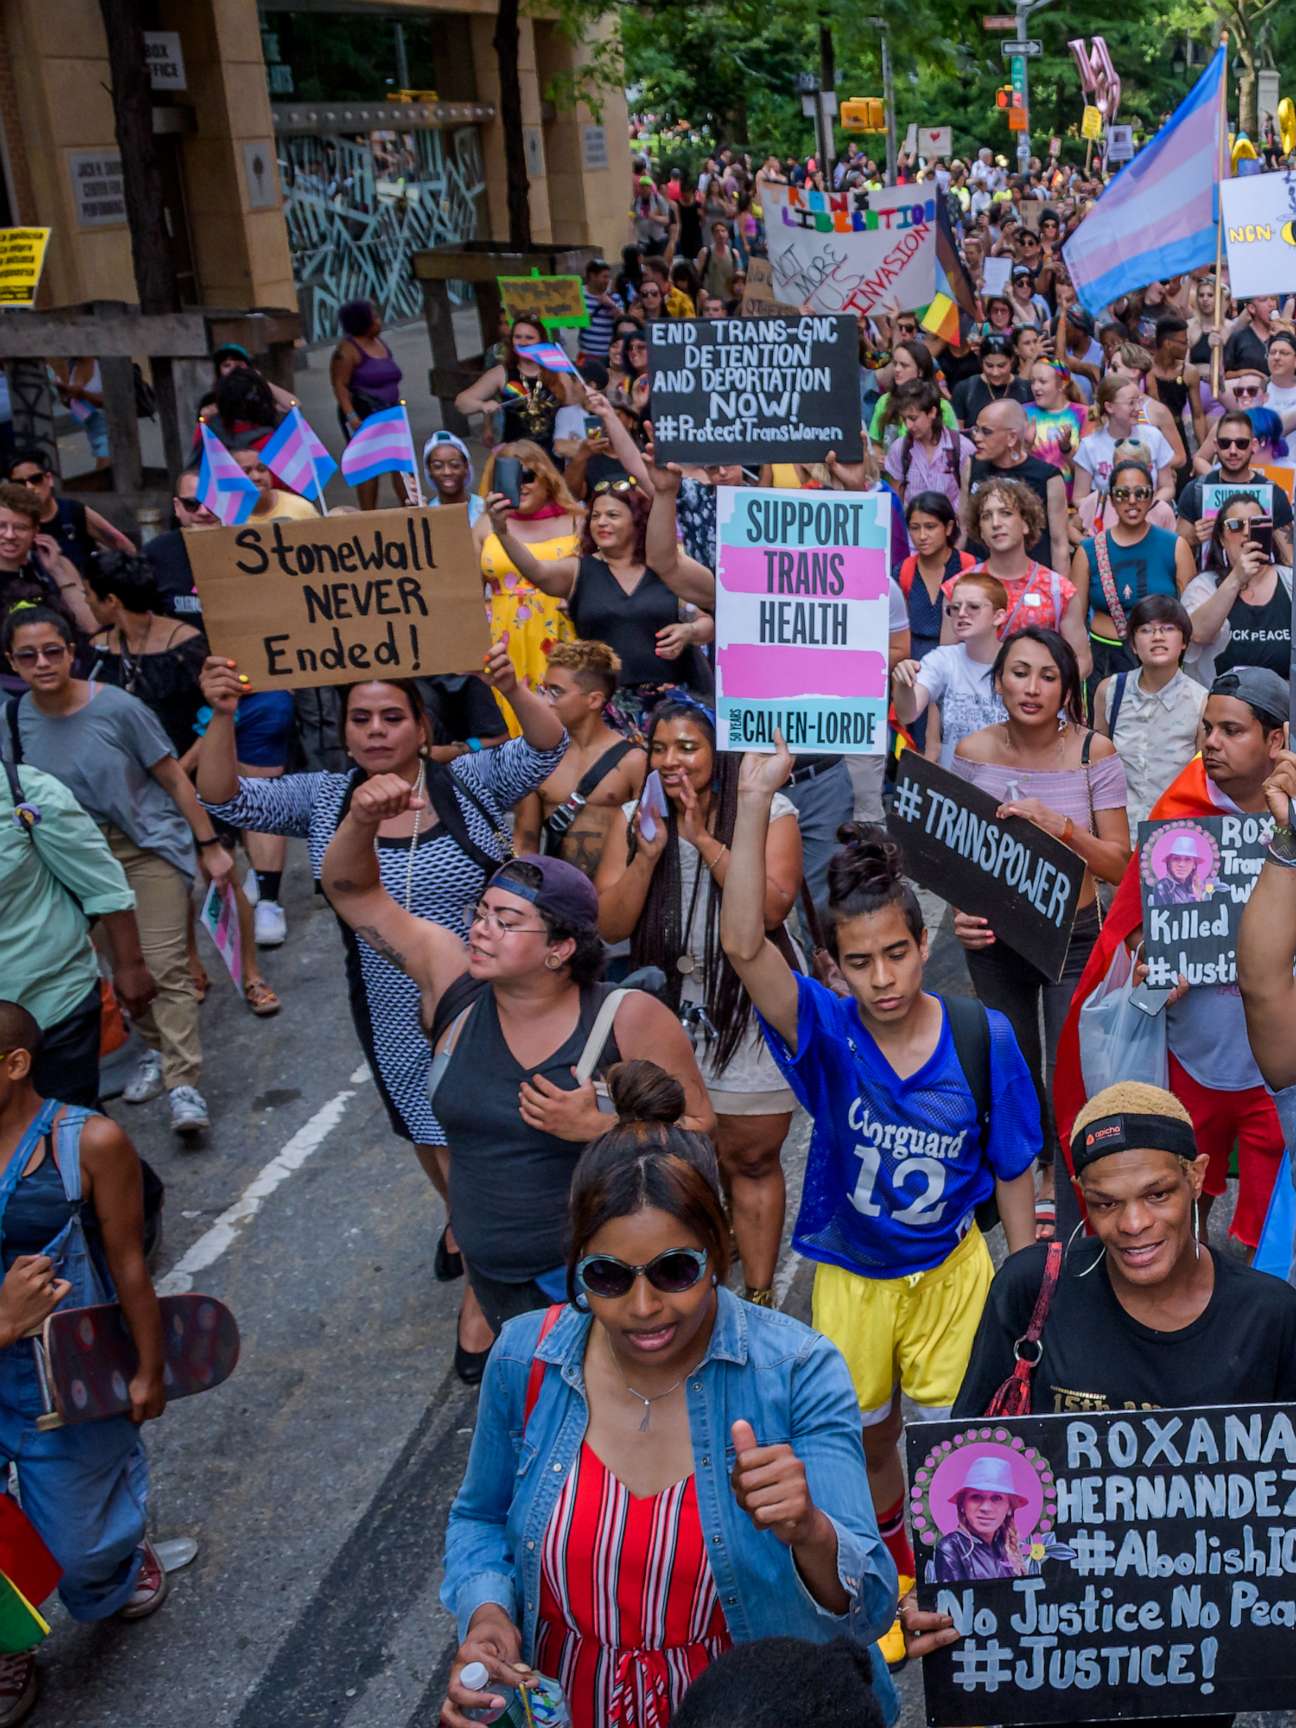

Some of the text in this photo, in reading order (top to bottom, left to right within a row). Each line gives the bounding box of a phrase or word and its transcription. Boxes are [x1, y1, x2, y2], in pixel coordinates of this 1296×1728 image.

[151, 62, 178, 78] FICE
[770, 243, 805, 288] NOT
[793, 244, 848, 299] MORE
[841, 222, 931, 316] INVASION
[651, 316, 839, 346] END TRANS-GNC
[684, 343, 811, 369] DETENTION
[652, 366, 832, 393] AND DEPORTATION
[709, 390, 801, 423] NOW!
[746, 499, 864, 547] SUPPORT
[763, 550, 845, 596] TRANS
[303, 576, 429, 624] NEVER
[759, 600, 849, 645] HEALTH
[729, 708, 742, 731] YEARS
[742, 709, 876, 746] CALLEN-LORDE
[893, 776, 1072, 929] #TRANSPOWER
[1221, 850, 1266, 876] Tran
[1150, 904, 1230, 944] Killed
[846, 1144, 948, 1226] 12
[936, 1588, 999, 1637] No
[1010, 1577, 1165, 1636] Justice
[1171, 1584, 1220, 1629] No
